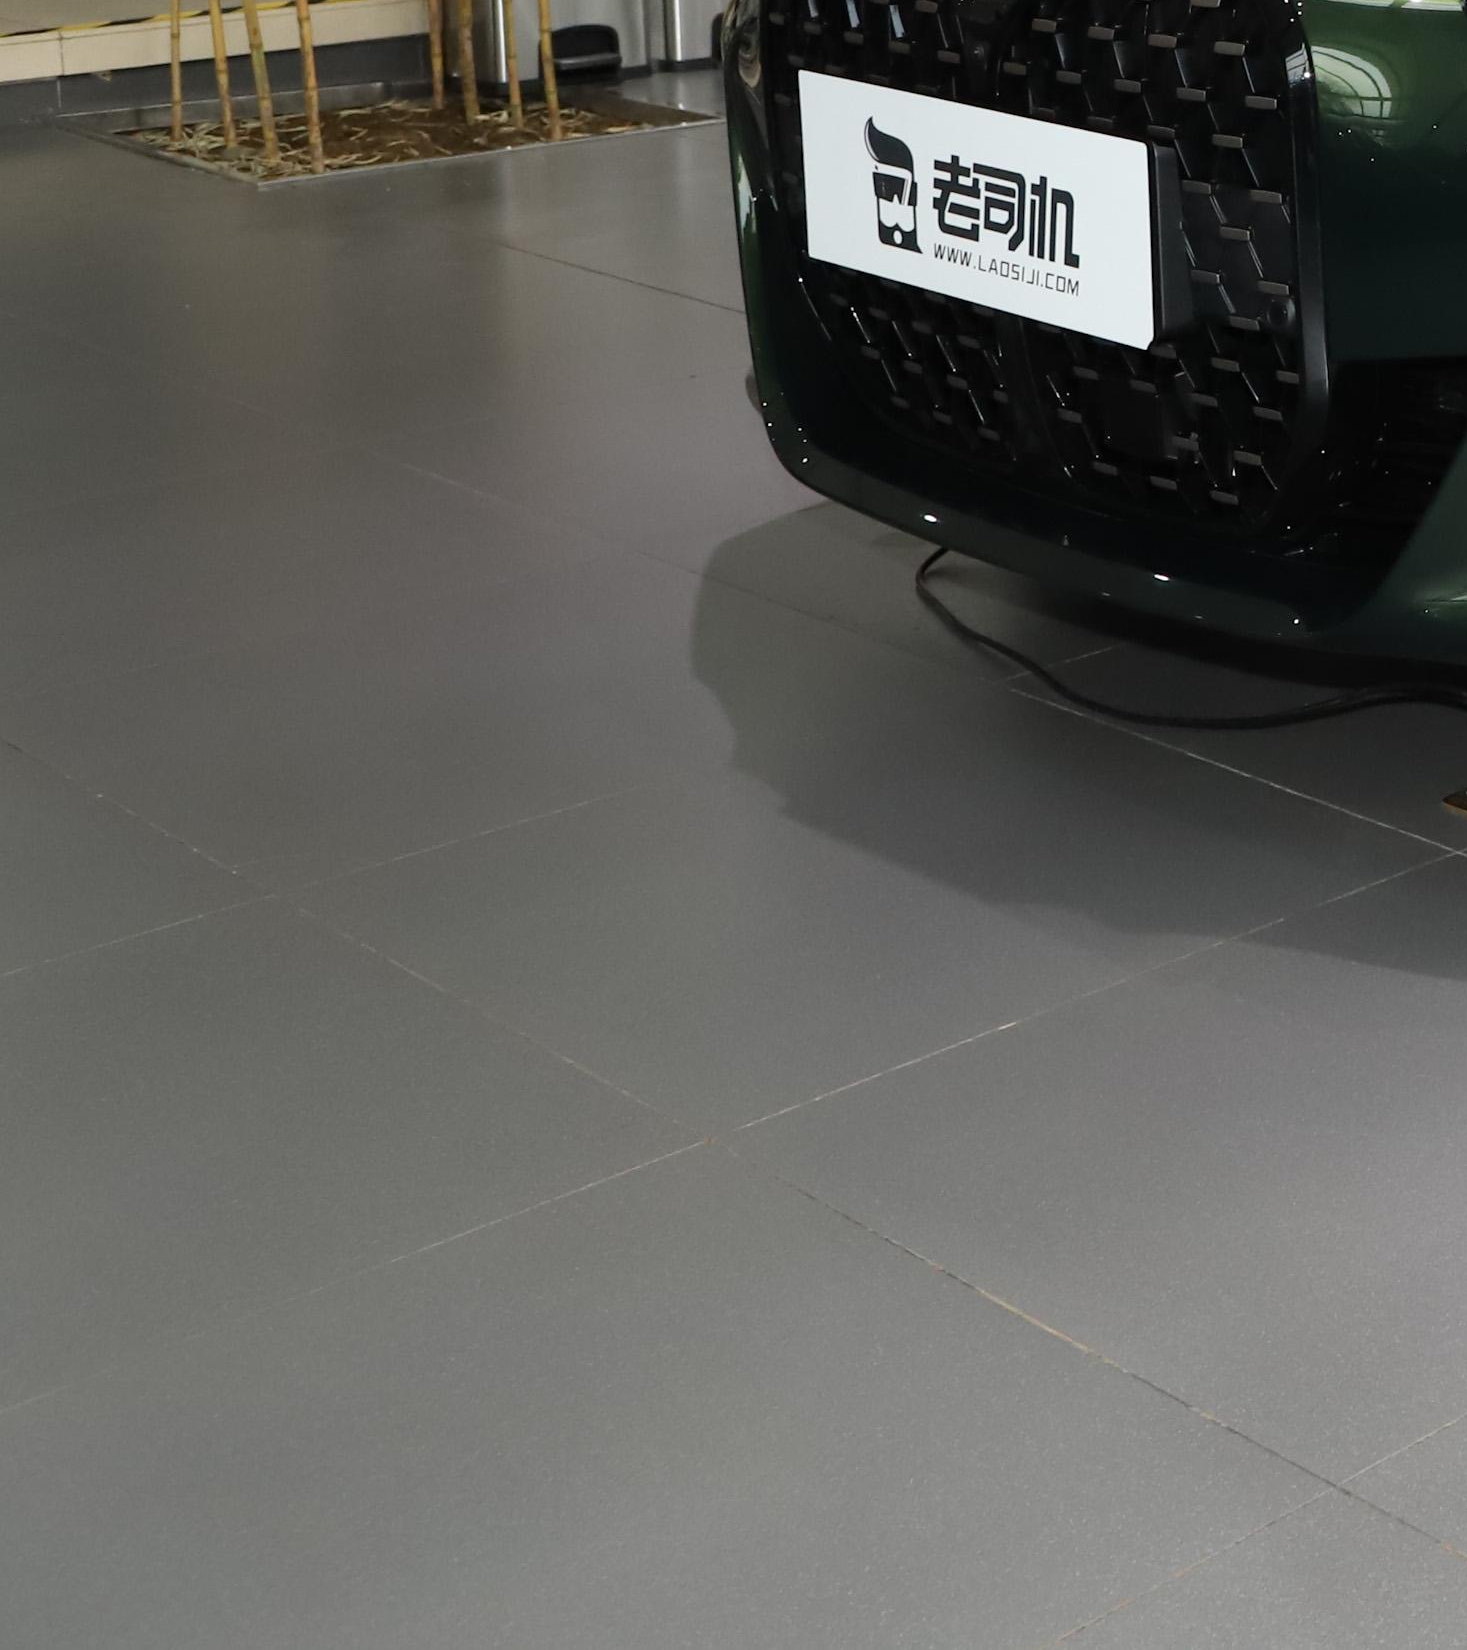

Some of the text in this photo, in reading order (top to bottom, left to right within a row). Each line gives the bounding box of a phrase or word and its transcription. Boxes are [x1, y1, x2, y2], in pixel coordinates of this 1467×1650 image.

[932, 154, 1080, 269] 老司机
[933, 243, 1080, 297] WWW.LAOSIJI.COM
